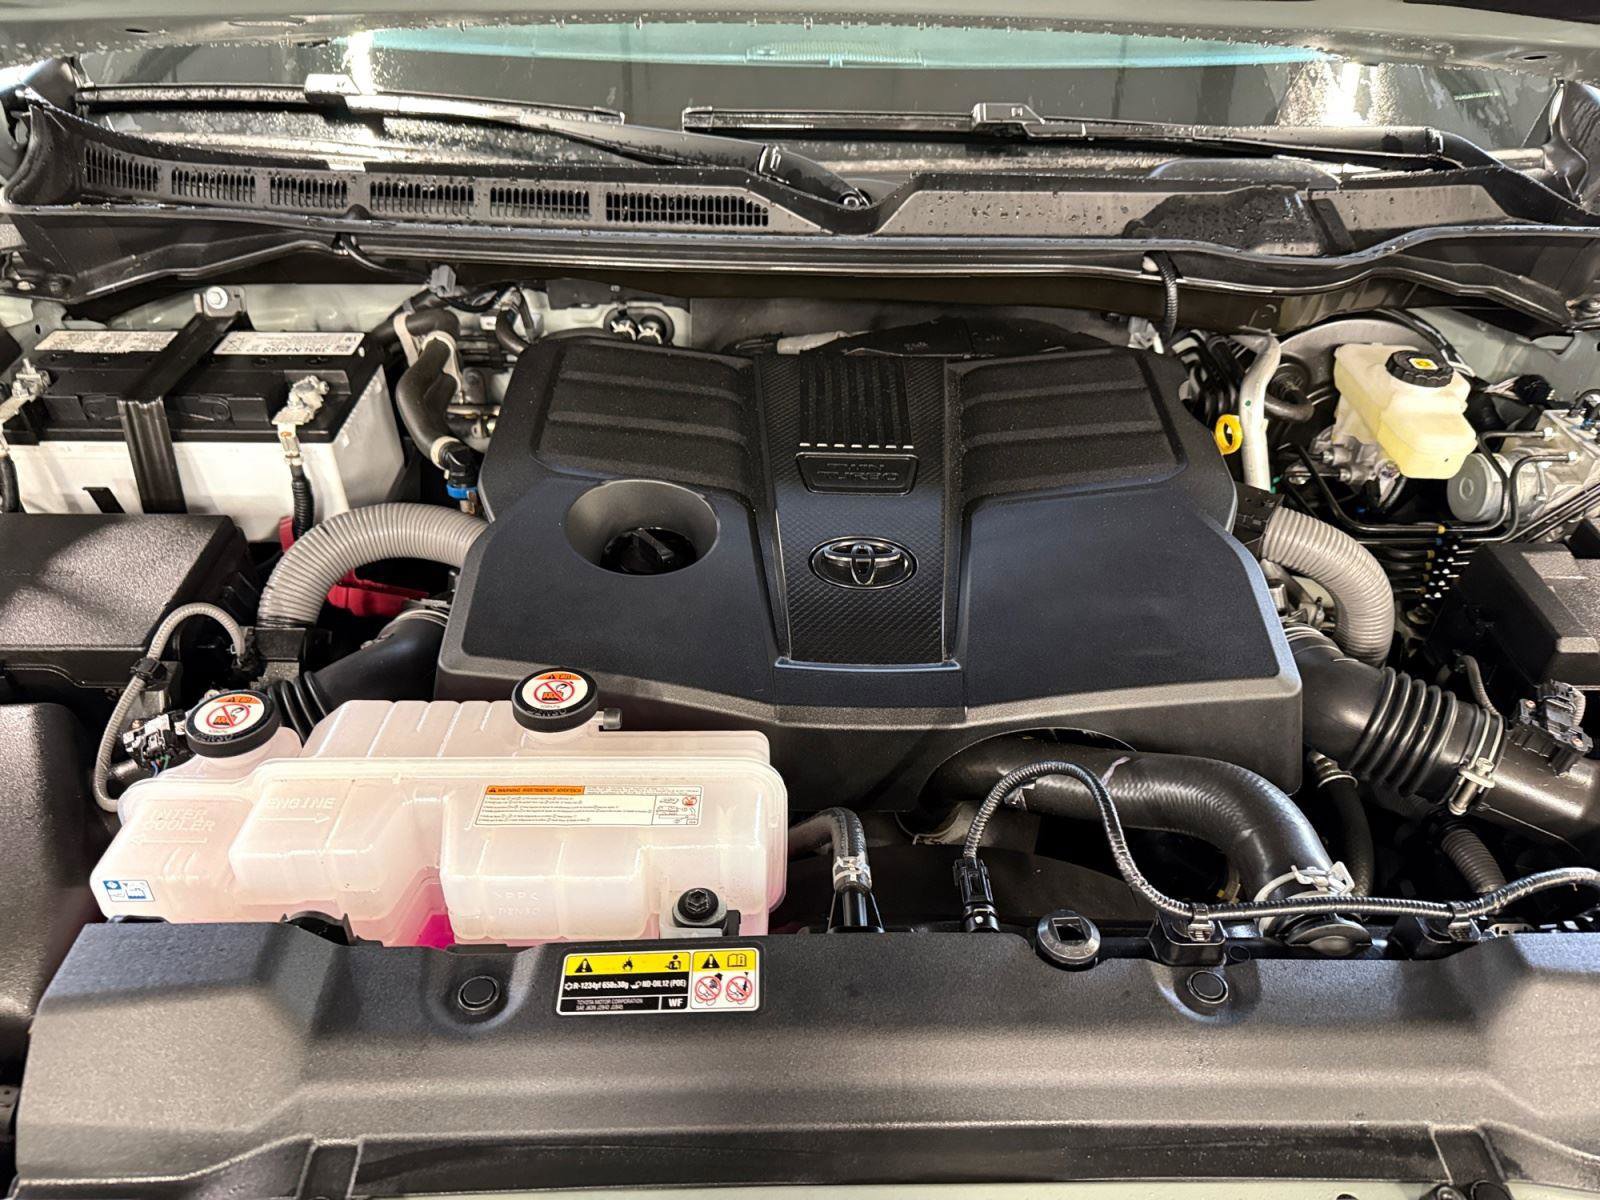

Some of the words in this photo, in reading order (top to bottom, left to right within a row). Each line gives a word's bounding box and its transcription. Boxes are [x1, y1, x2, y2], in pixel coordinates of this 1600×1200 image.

[817, 471, 899, 480] TURBO
[267, 797, 336, 809] ENGINE
[152, 808, 208, 820] INTER
[143, 820, 215, 832] COOLER
[573, 981, 602, 991] R-1234yf
[670, 979, 687, 988] (POE)
[668, 998, 684, 1008] WF
